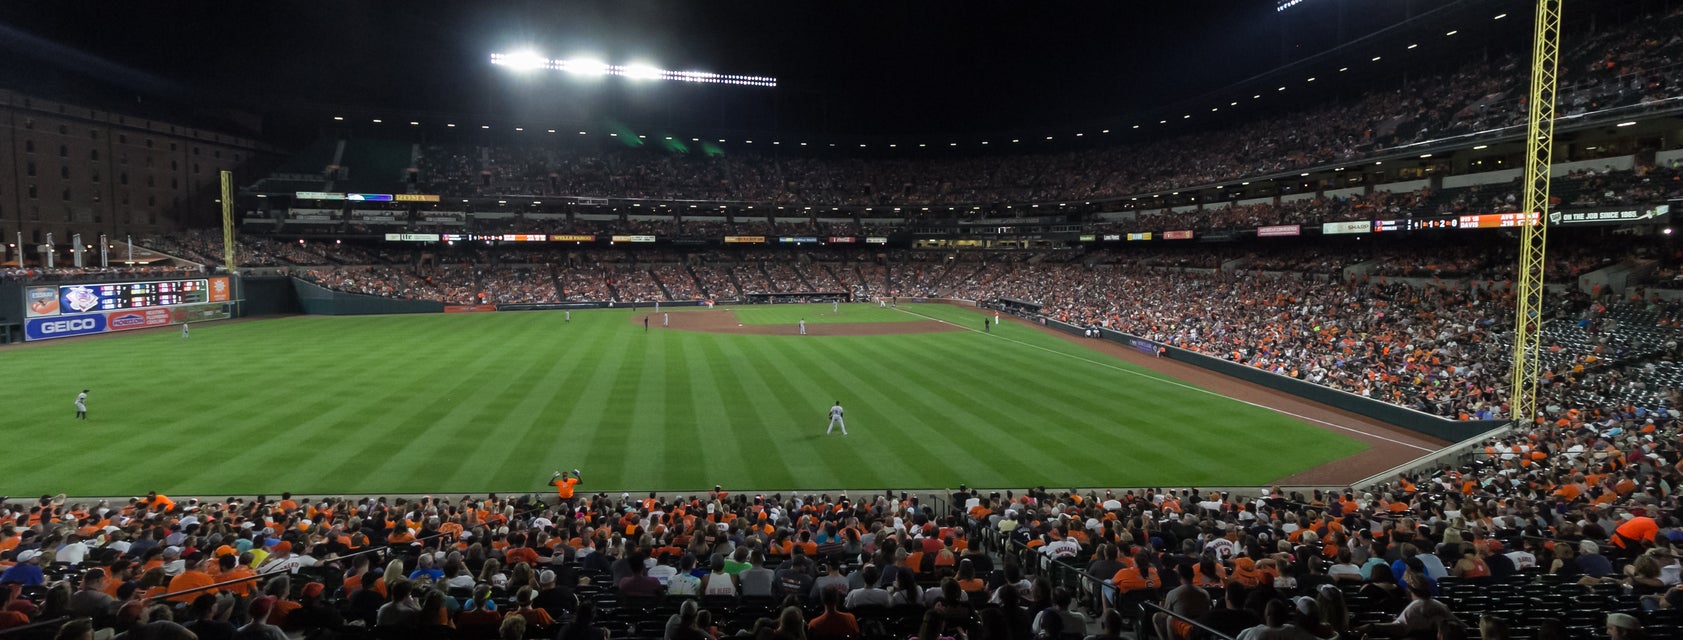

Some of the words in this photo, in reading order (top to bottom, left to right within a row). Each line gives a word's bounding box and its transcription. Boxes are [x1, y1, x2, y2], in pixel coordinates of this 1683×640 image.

[1599, 211, 1619, 219] SINCE
[1439, 219, 1446, 228] 2
[41, 318, 96, 334] GEICO
